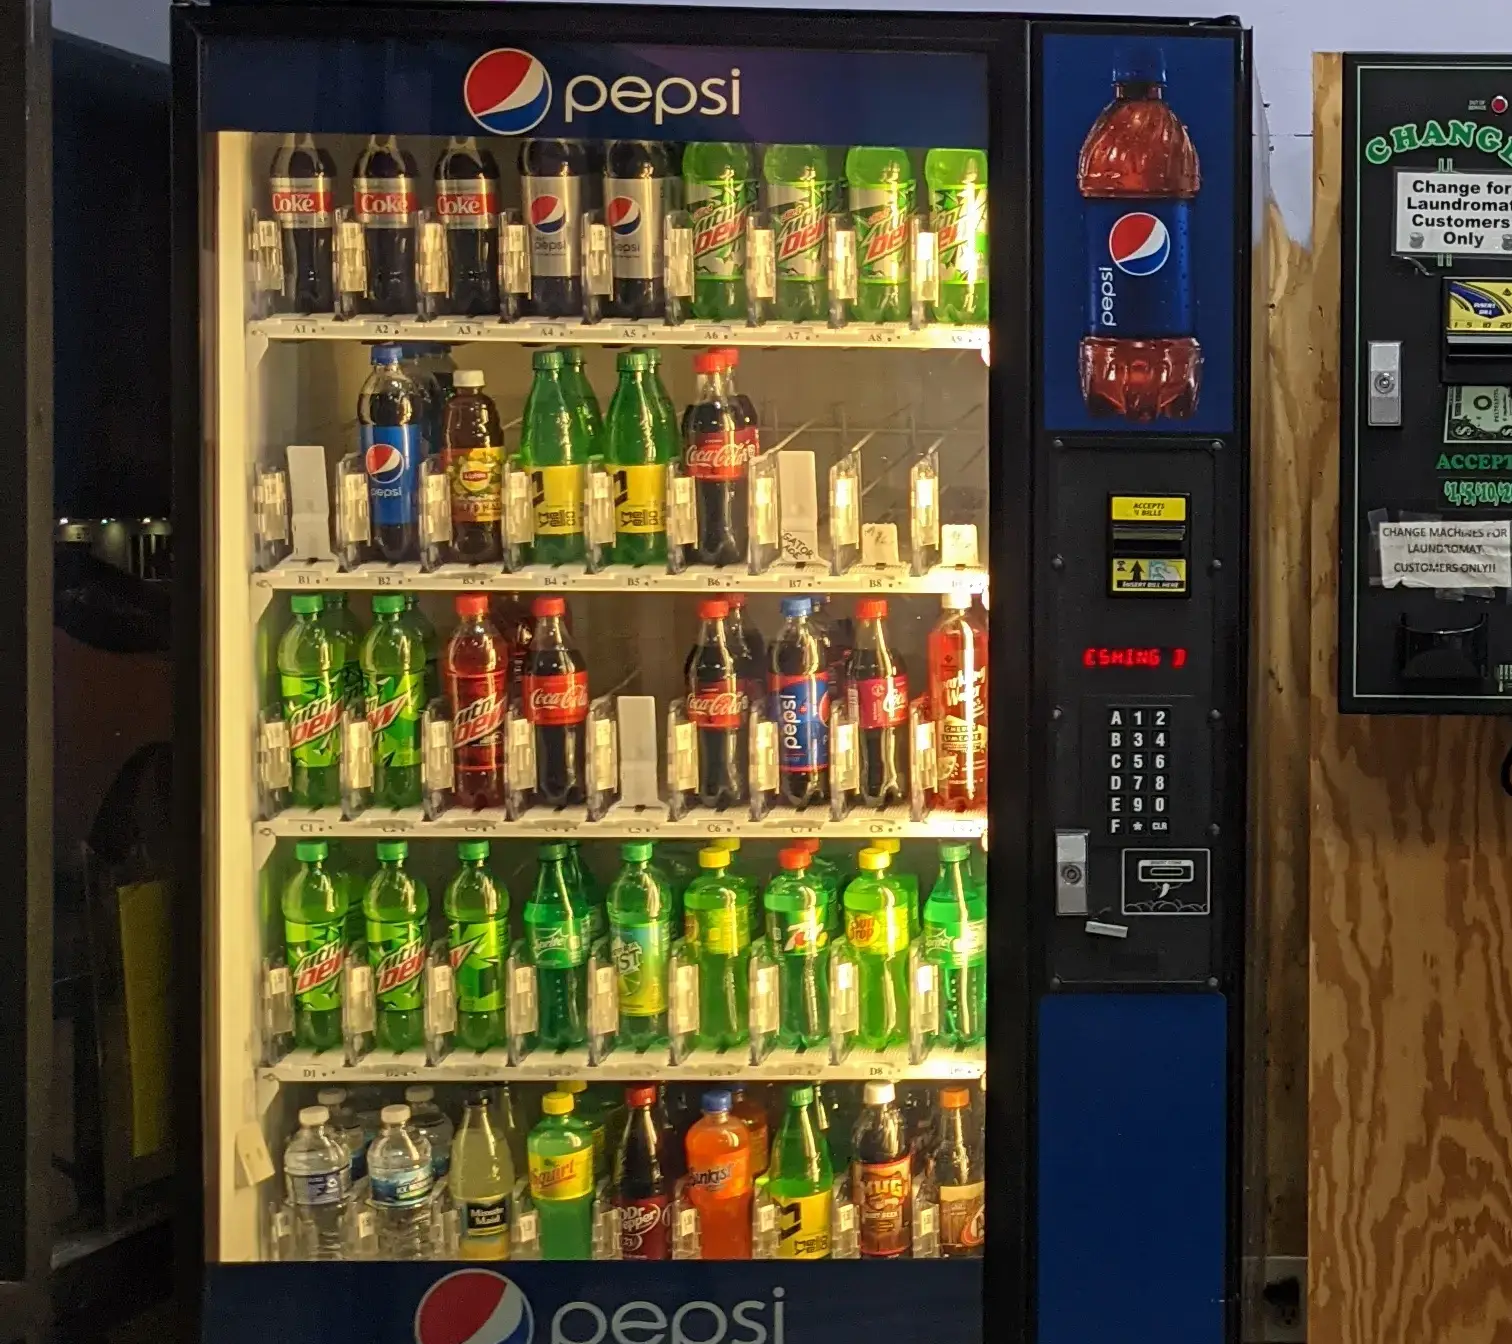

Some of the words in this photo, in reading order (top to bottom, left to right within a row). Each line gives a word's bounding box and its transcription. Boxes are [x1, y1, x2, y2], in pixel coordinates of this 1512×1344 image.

[565, 68, 740, 125] pepsi
[1412, 180, 1480, 196] Change
[1487, 181, 1512, 194] for
[272, 193, 315, 213] Coke
[437, 194, 480, 215] Coke
[1412, 214, 1510, 228] Customers
[1444, 232, 1484, 248] Only
[1100, 267, 1117, 326] pepsi
[293, 325, 306, 334] A1
[375, 325, 388, 334] A2
[457, 325, 471, 334] A3
[540, 327, 553, 336] A4
[622, 329, 636, 338] A5
[704, 331, 718, 340] A6
[868, 334, 882, 342] A8
[1383, 527, 1426, 537] CHANGE
[782, 530, 814, 559] GATOR
[1394, 563, 1458, 573] CUSTOMERS
[298, 576, 311, 585] B1
[378, 576, 391, 585] B2
[707, 578, 720, 587] B6
[869, 579, 882, 588] B8
[784, 694, 798, 750] pepsi
[1111, 711, 1121, 725] A
[1135, 711, 1142, 725] 1
[1156, 711, 1165, 725] 2
[1111, 732, 1121, 747] B
[1133, 732, 1143, 747] 3
[1155, 732, 1165, 747] 4
[1111, 754, 1121, 768] C
[1133, 754, 1143, 769] 5
[1155, 754, 1165, 768] 6
[1111, 776, 1121, 790] D
[1134, 776, 1143, 790] 7
[1155, 776, 1165, 790] 8
[1111, 798, 1121, 812] E
[1133, 798, 1142, 812] 9
[1155, 798, 1164, 812] 0
[1111, 819, 1120, 833] F
[1152, 822, 1168, 831] CLR
[303, 1069, 316, 1078] D1
[869, 1067, 883, 1076] D8
